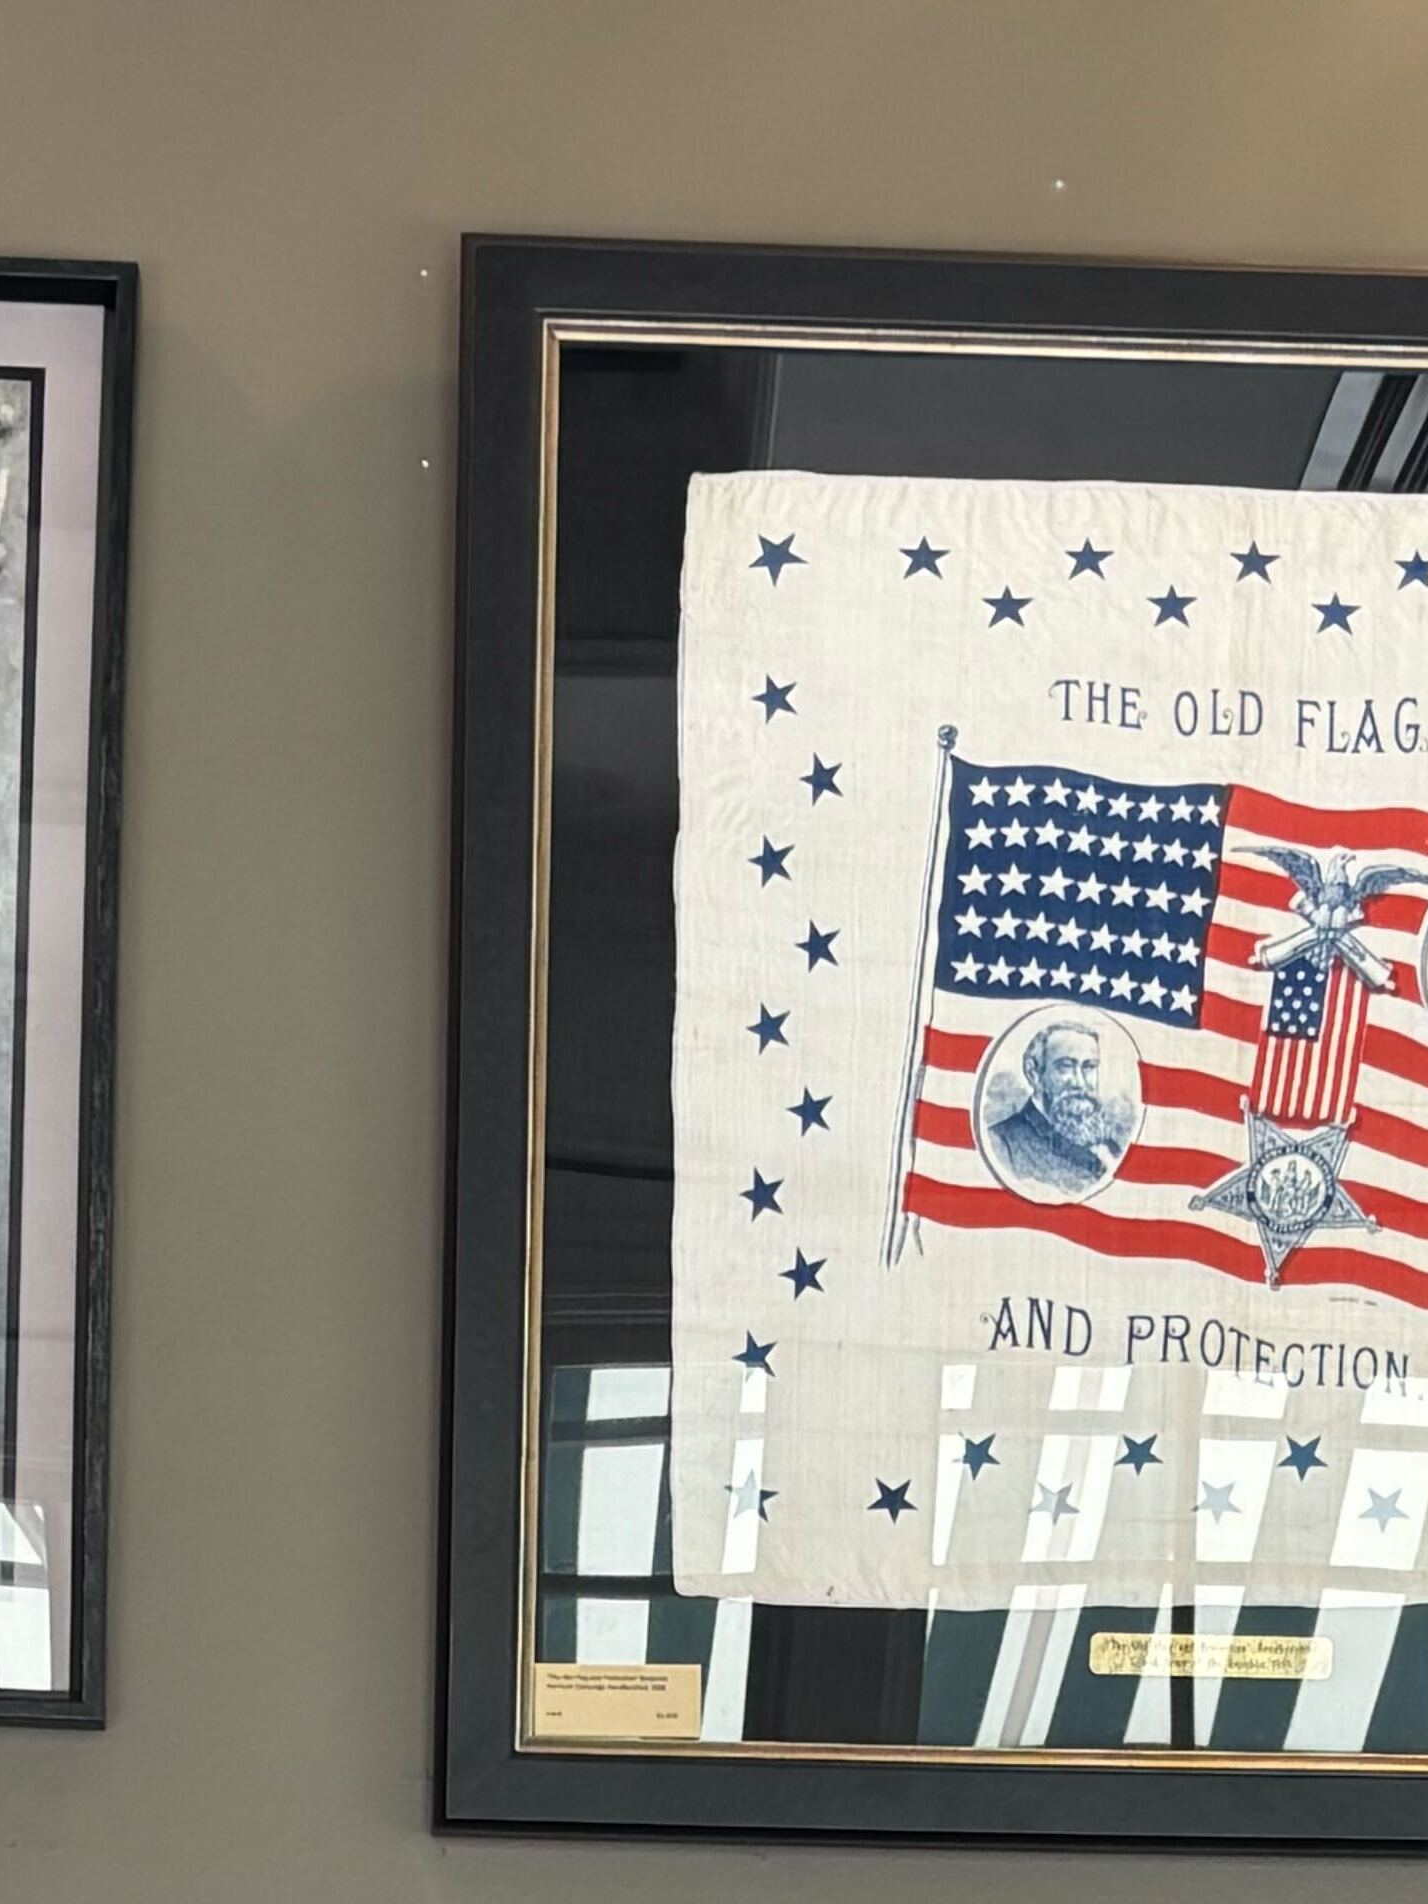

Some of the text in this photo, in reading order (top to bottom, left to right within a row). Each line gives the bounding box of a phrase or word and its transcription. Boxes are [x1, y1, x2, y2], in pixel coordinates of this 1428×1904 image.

[1048, 679, 1147, 732] THE
[1173, 689, 1265, 738] OLD
[979, 1296, 1093, 1357] AND
